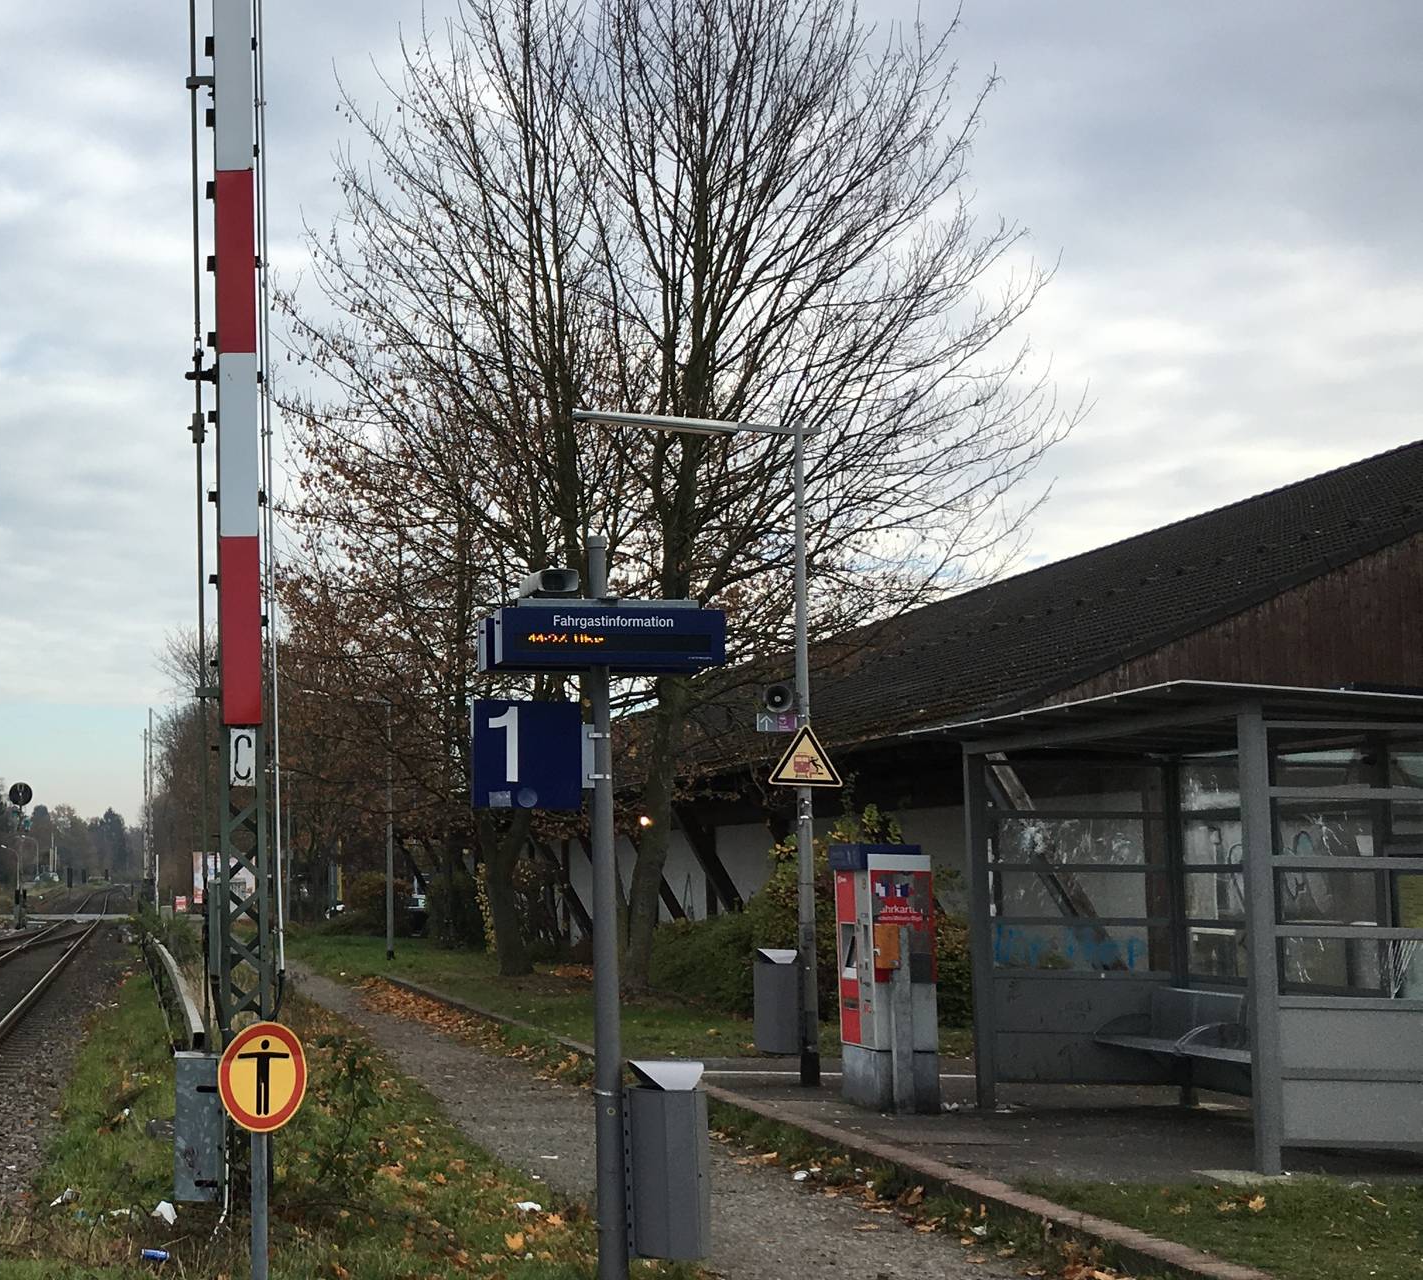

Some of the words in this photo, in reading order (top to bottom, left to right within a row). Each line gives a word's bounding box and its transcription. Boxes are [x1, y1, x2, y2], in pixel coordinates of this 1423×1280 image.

[553, 615, 674, 629] Fahrgastinformation
[235, 734, 252, 780] C
[489, 706, 518, 782] 1
